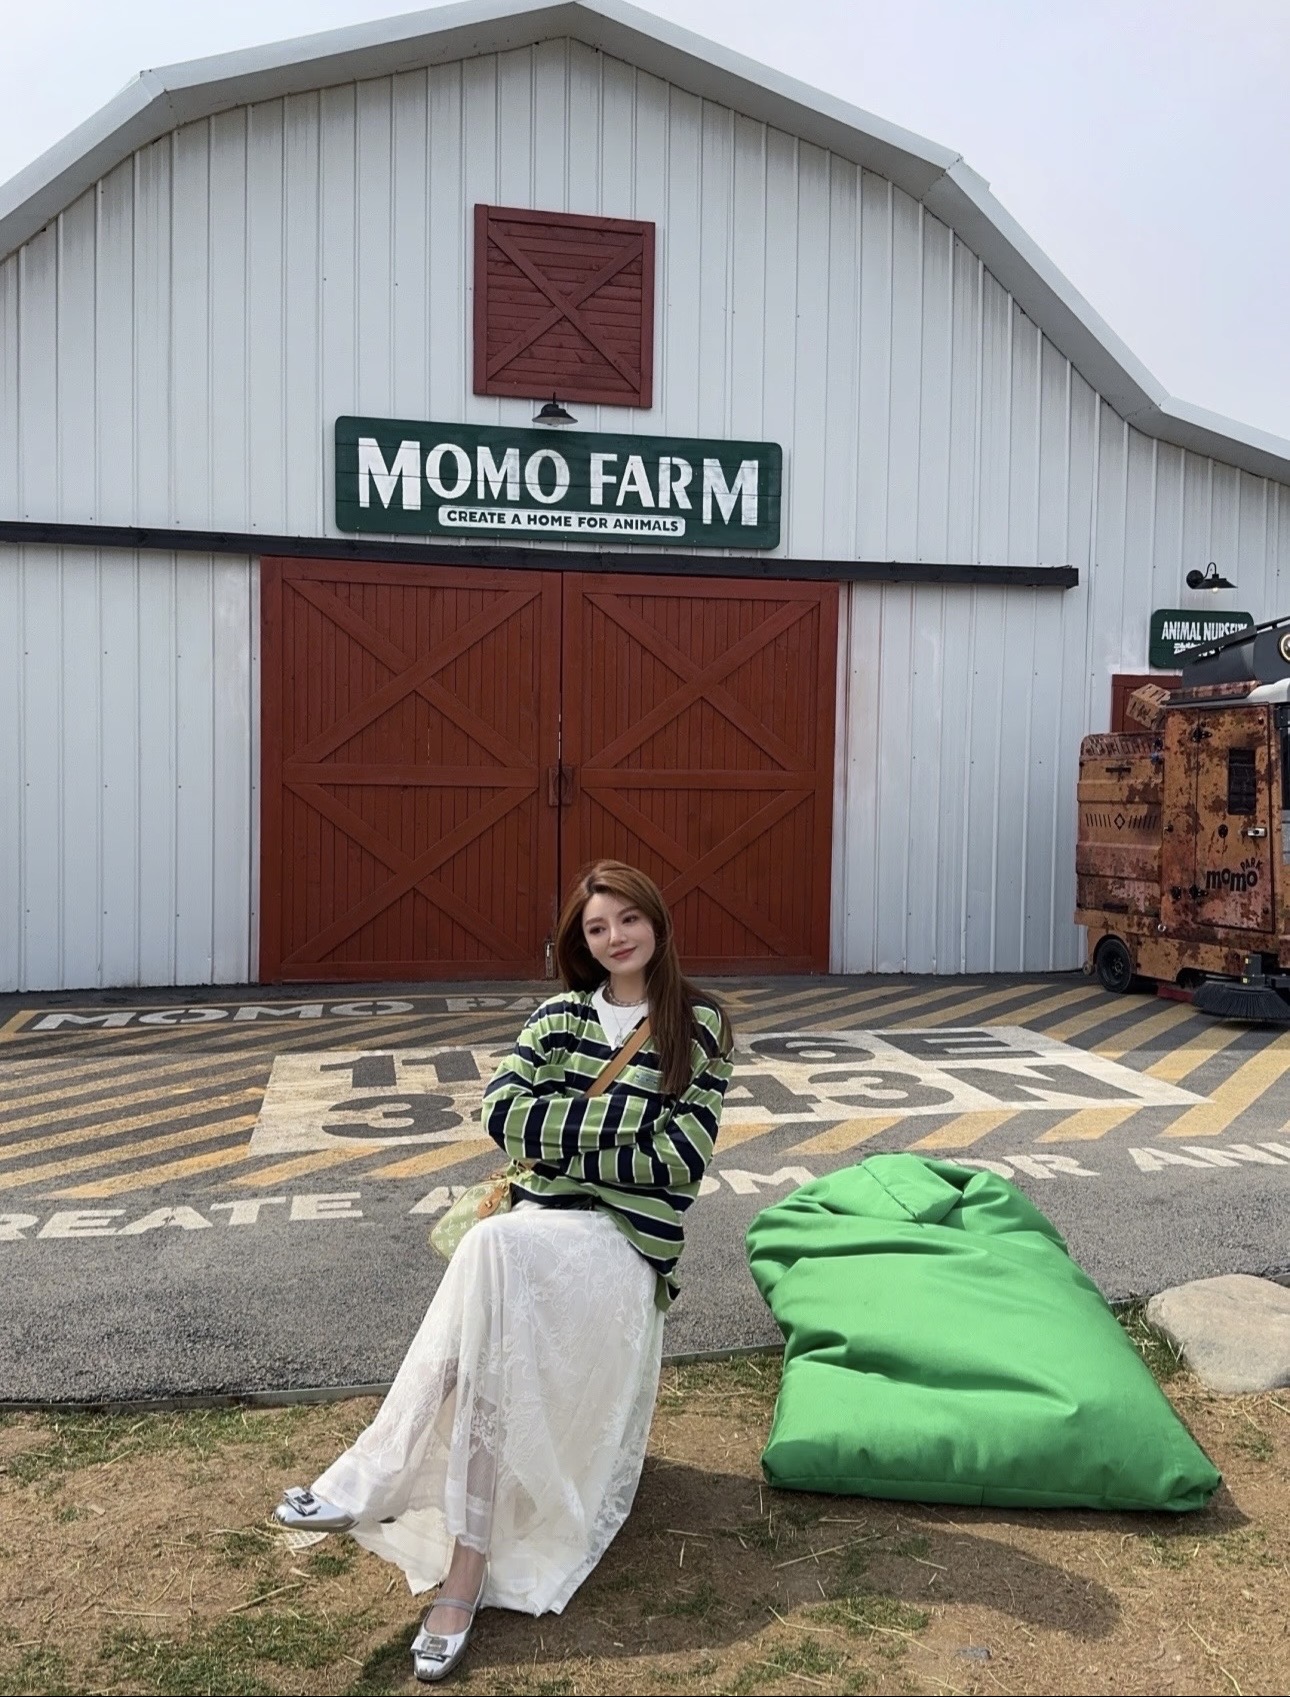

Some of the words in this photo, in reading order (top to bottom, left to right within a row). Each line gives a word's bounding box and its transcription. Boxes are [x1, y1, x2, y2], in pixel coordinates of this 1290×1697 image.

[358, 437, 570, 511] MOMO
[590, 453, 759, 526] FARM
[447, 510, 506, 525] CREATE
[511, 513, 522, 525] A
[527, 514, 572, 528] HOME
[577, 516, 609, 530] FOR
[613, 518, 679, 532] ANIMALS
[1161, 621, 1201, 641] ANIMAL
[1206, 868, 1258, 892] momo
[31, 999, 414, 1030] MOMO
[0, 1192, 363, 1241] REATE
